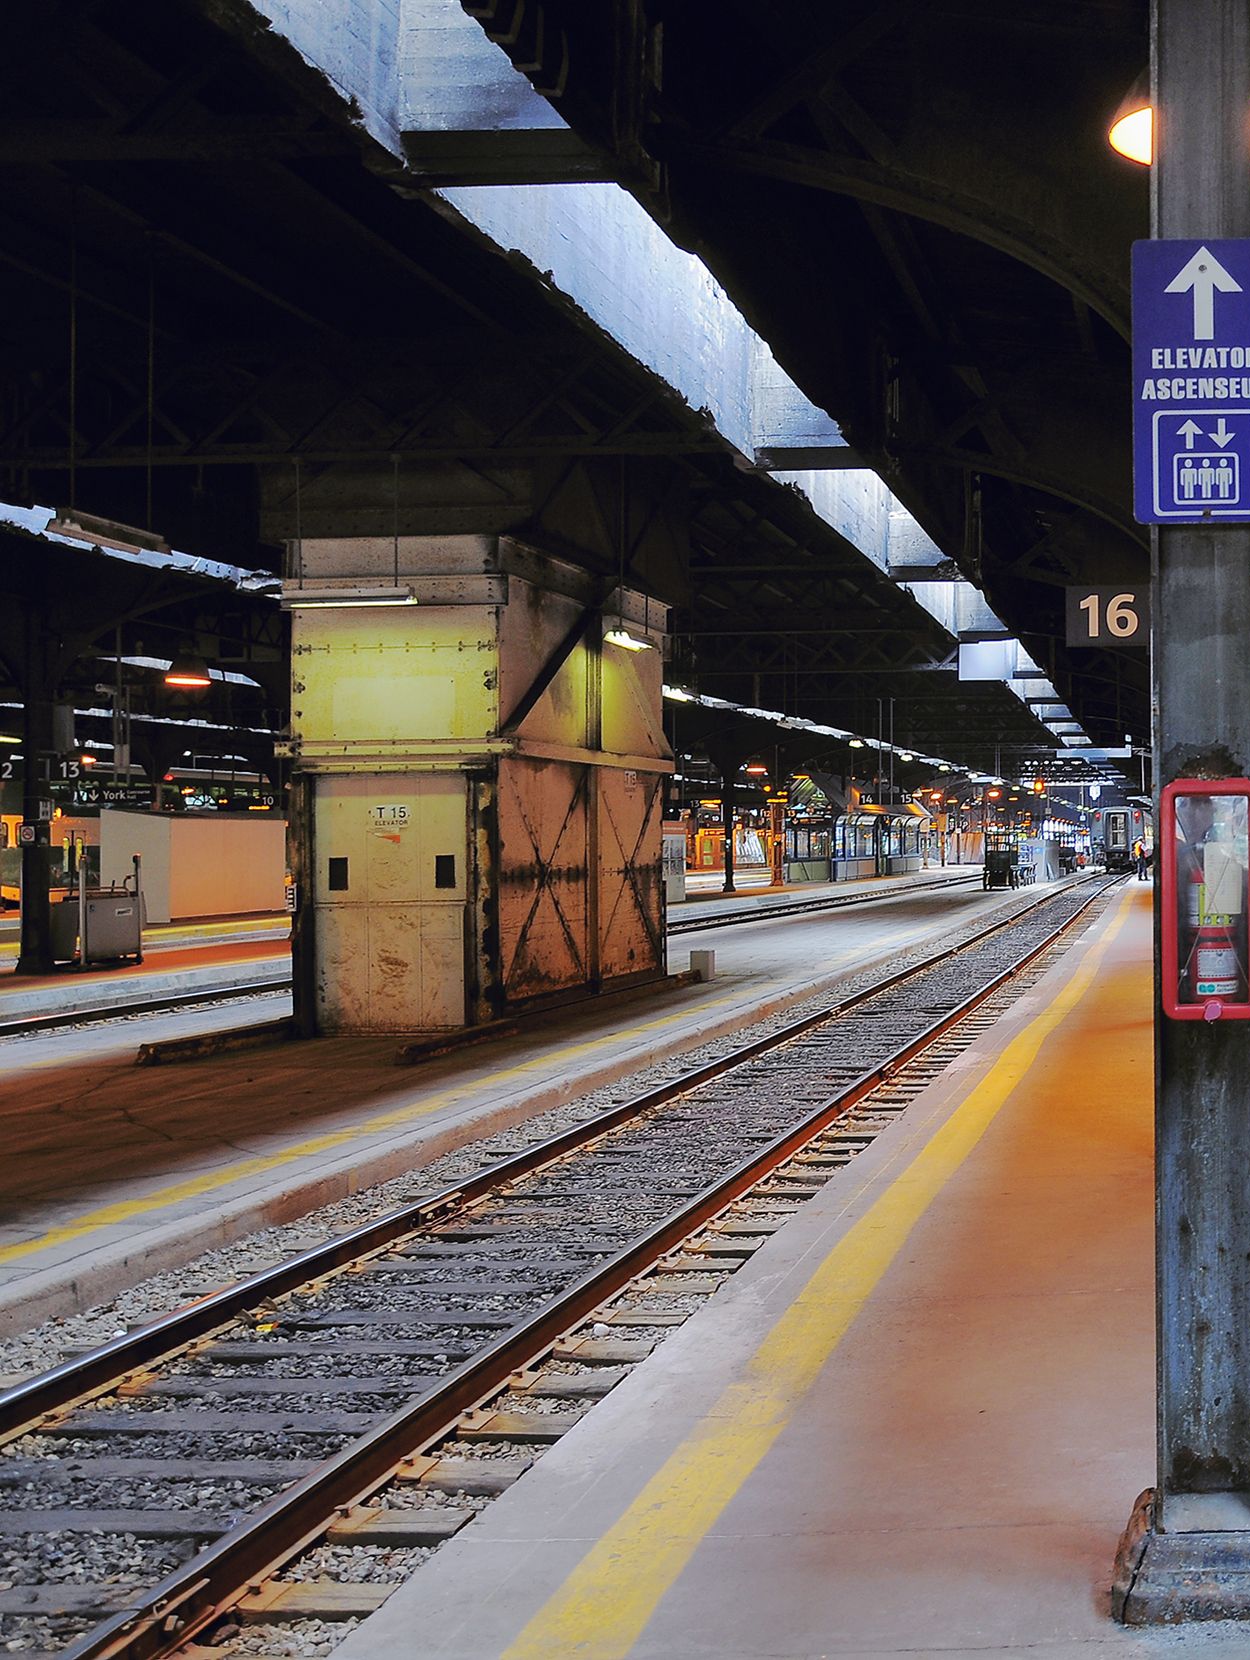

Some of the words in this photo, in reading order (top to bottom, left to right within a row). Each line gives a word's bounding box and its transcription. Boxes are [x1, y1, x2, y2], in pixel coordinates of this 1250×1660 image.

[1079, 593, 1139, 638] 16
[60, 761, 80, 778] 13
[102, 790, 126, 800] York
[861, 794, 873, 804] 14
[900, 793, 912, 803] 15
[262, 796, 274, 805] 10
[376, 807, 385, 818] T
[391, 806, 406, 818] 15
